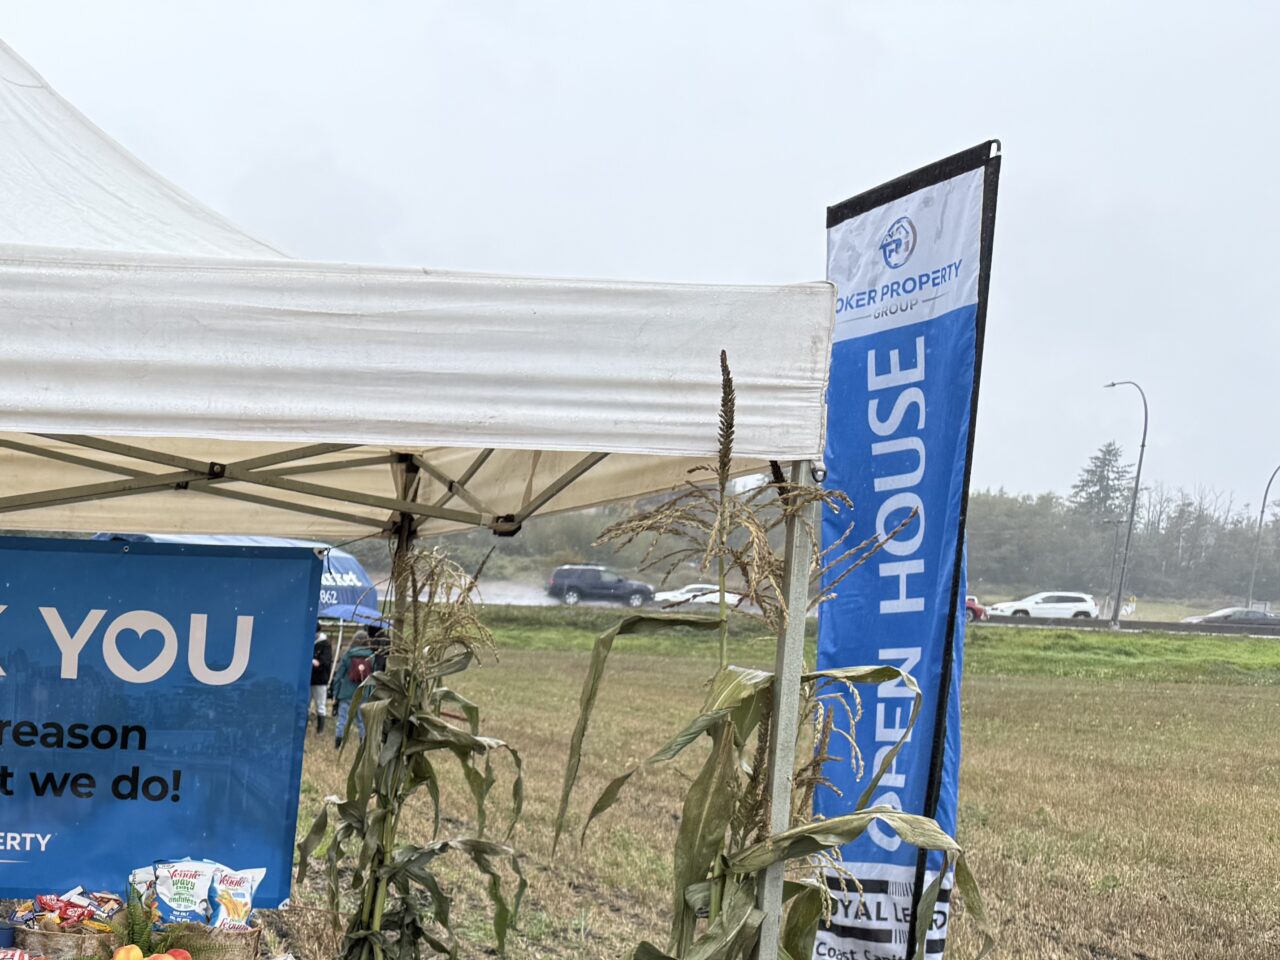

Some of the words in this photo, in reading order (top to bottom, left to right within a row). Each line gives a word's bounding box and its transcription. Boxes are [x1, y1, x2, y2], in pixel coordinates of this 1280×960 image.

[880, 259, 963, 301] PROPERTY
[873, 298, 919, 319] GROUP
[867, 335, 927, 614] HOUSE
[39, 606, 254, 686] YOU
[867, 646, 922, 853] OPEN
[28, 771, 96, 799] we
[111, 765, 183, 803] do!
[831, 898, 888, 922] YAL
